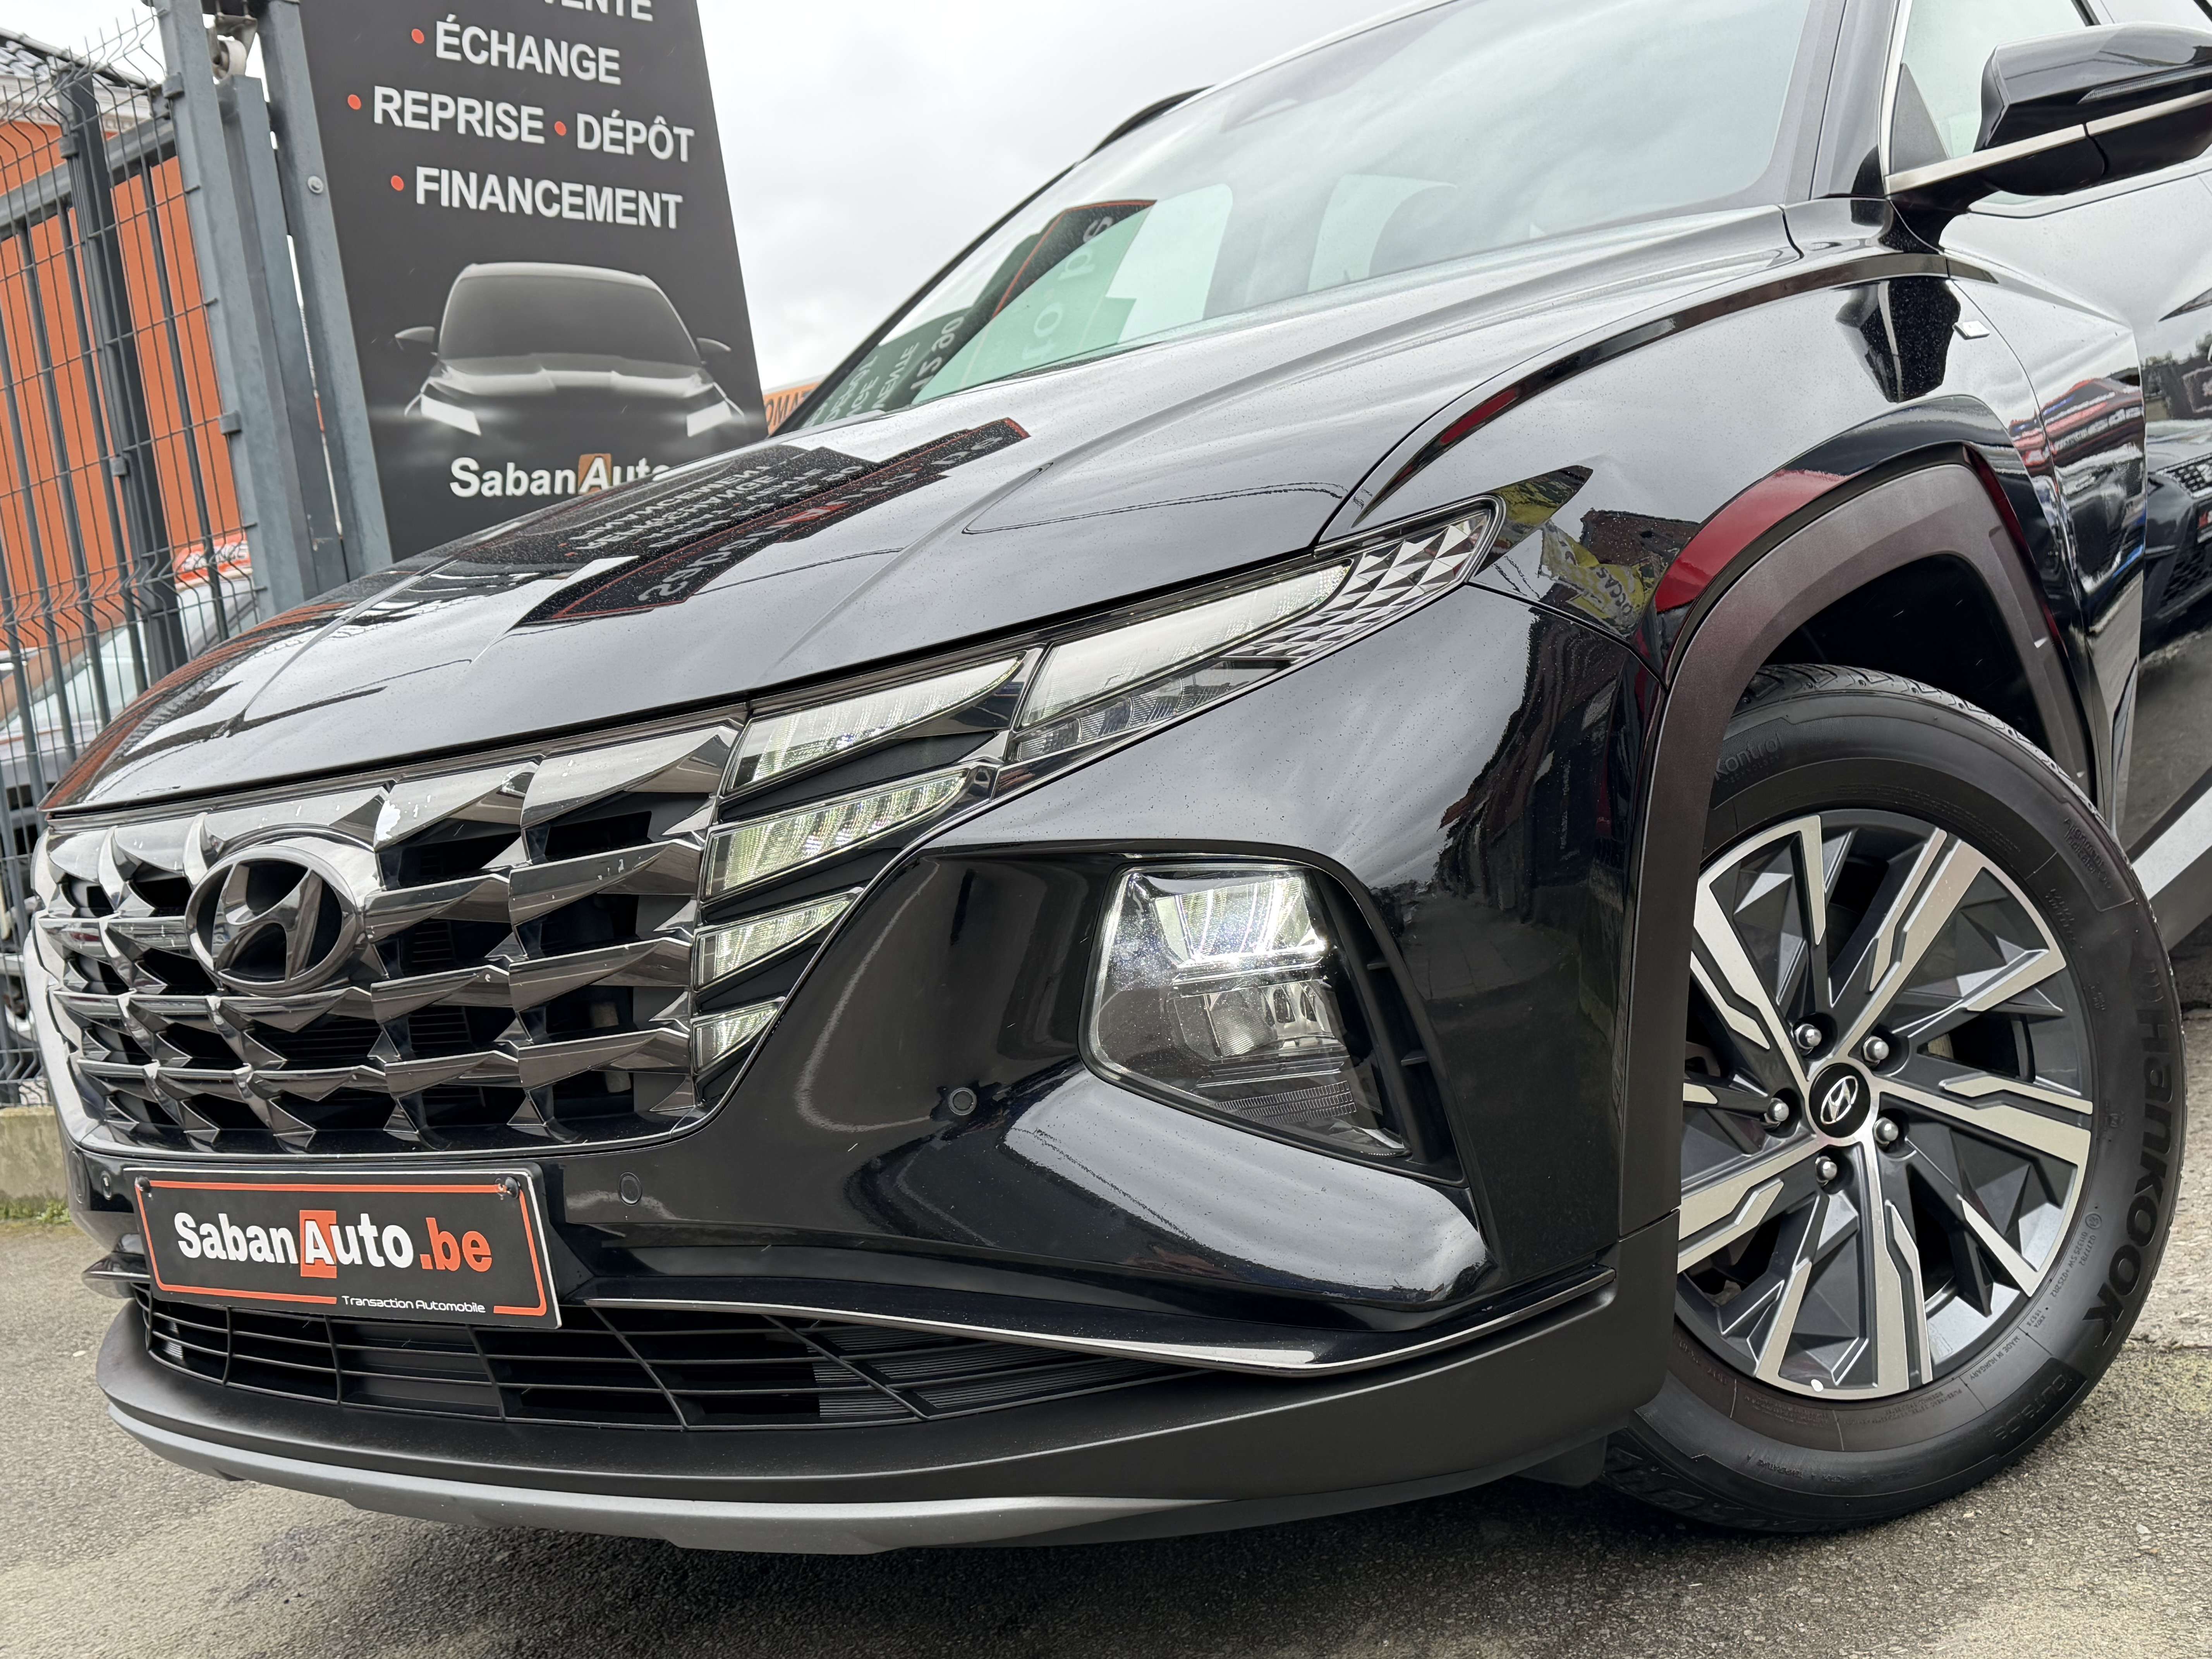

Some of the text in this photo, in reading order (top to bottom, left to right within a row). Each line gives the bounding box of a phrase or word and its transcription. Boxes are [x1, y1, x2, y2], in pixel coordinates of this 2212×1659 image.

[436, 14, 621, 84] ÉCHANGE
[373, 86, 694, 162] REPRISE DÉPÔT
[416, 166, 683, 229] FINANCEMENT
[174, 1212, 492, 1273] SabanAuto.be
[342, 1295, 486, 1314] Transaction Automobile
